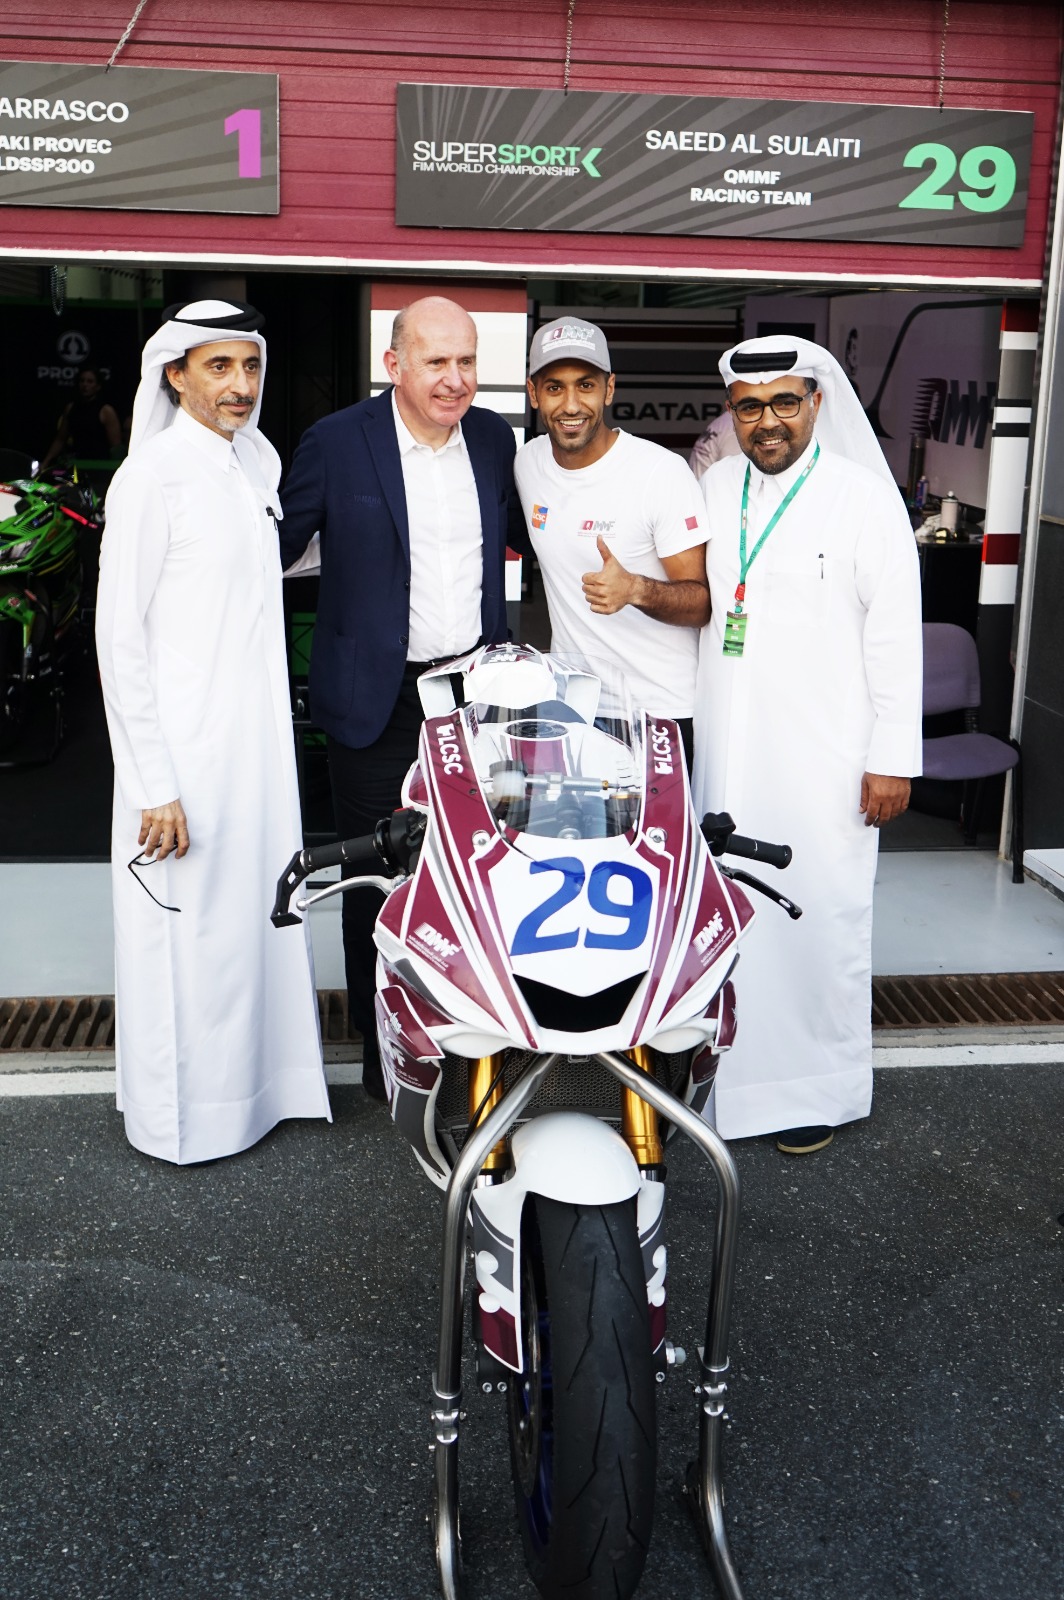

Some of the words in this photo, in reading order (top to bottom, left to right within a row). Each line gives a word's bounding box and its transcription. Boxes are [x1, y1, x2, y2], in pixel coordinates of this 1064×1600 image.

[0, 97, 129, 123] ARRASCO
[0, 135, 30, 151] AKI
[33, 136, 112, 154] PROVEC
[224, 109, 261, 178] 1
[413, 141, 582, 166] SUPERSPORT
[645, 130, 726, 152] SAEED
[731, 133, 763, 154] AL
[768, 135, 861, 158] SULAITI
[0, 156, 95, 174] LDSSP300
[413, 161, 435, 171] FIM
[436, 163, 483, 173] WORLD
[485, 163, 580, 176] CHAMPIONSHIP
[723, 169, 781, 184] QMMF
[899, 143, 1016, 212] 29
[690, 187, 760, 204] RACING
[762, 190, 812, 206] TEAM
[579, 520, 616, 532] QMMF
[437, 735, 464, 775] LCSC
[651, 724, 673, 762] LCSC
[510, 856, 653, 957] 29
